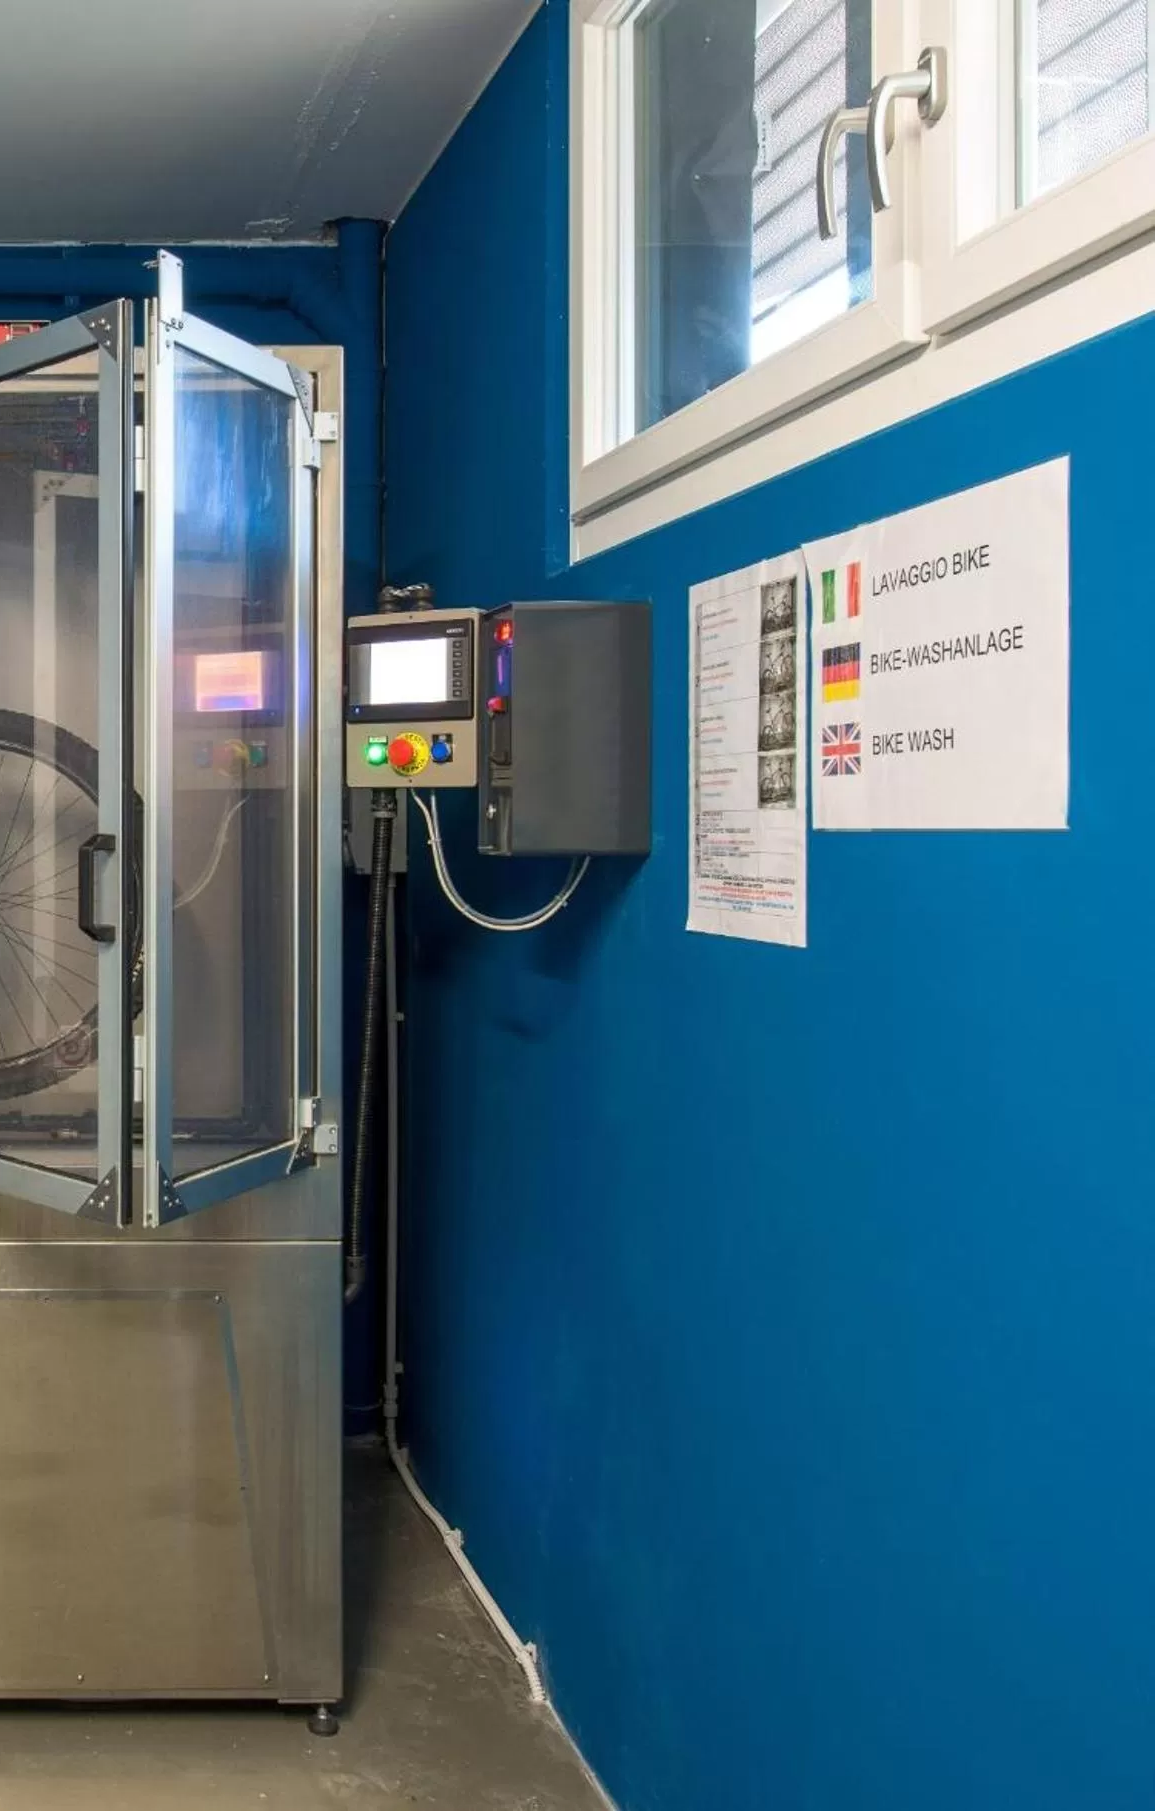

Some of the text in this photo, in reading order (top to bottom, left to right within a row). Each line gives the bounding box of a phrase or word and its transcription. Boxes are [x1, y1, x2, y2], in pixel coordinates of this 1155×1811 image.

[872, 544, 991, 597] LAVAGGIO BIKE
[870, 625, 1024, 675] BIKE-WASHANLAGE
[872, 727, 955, 756] BIKE WASH
